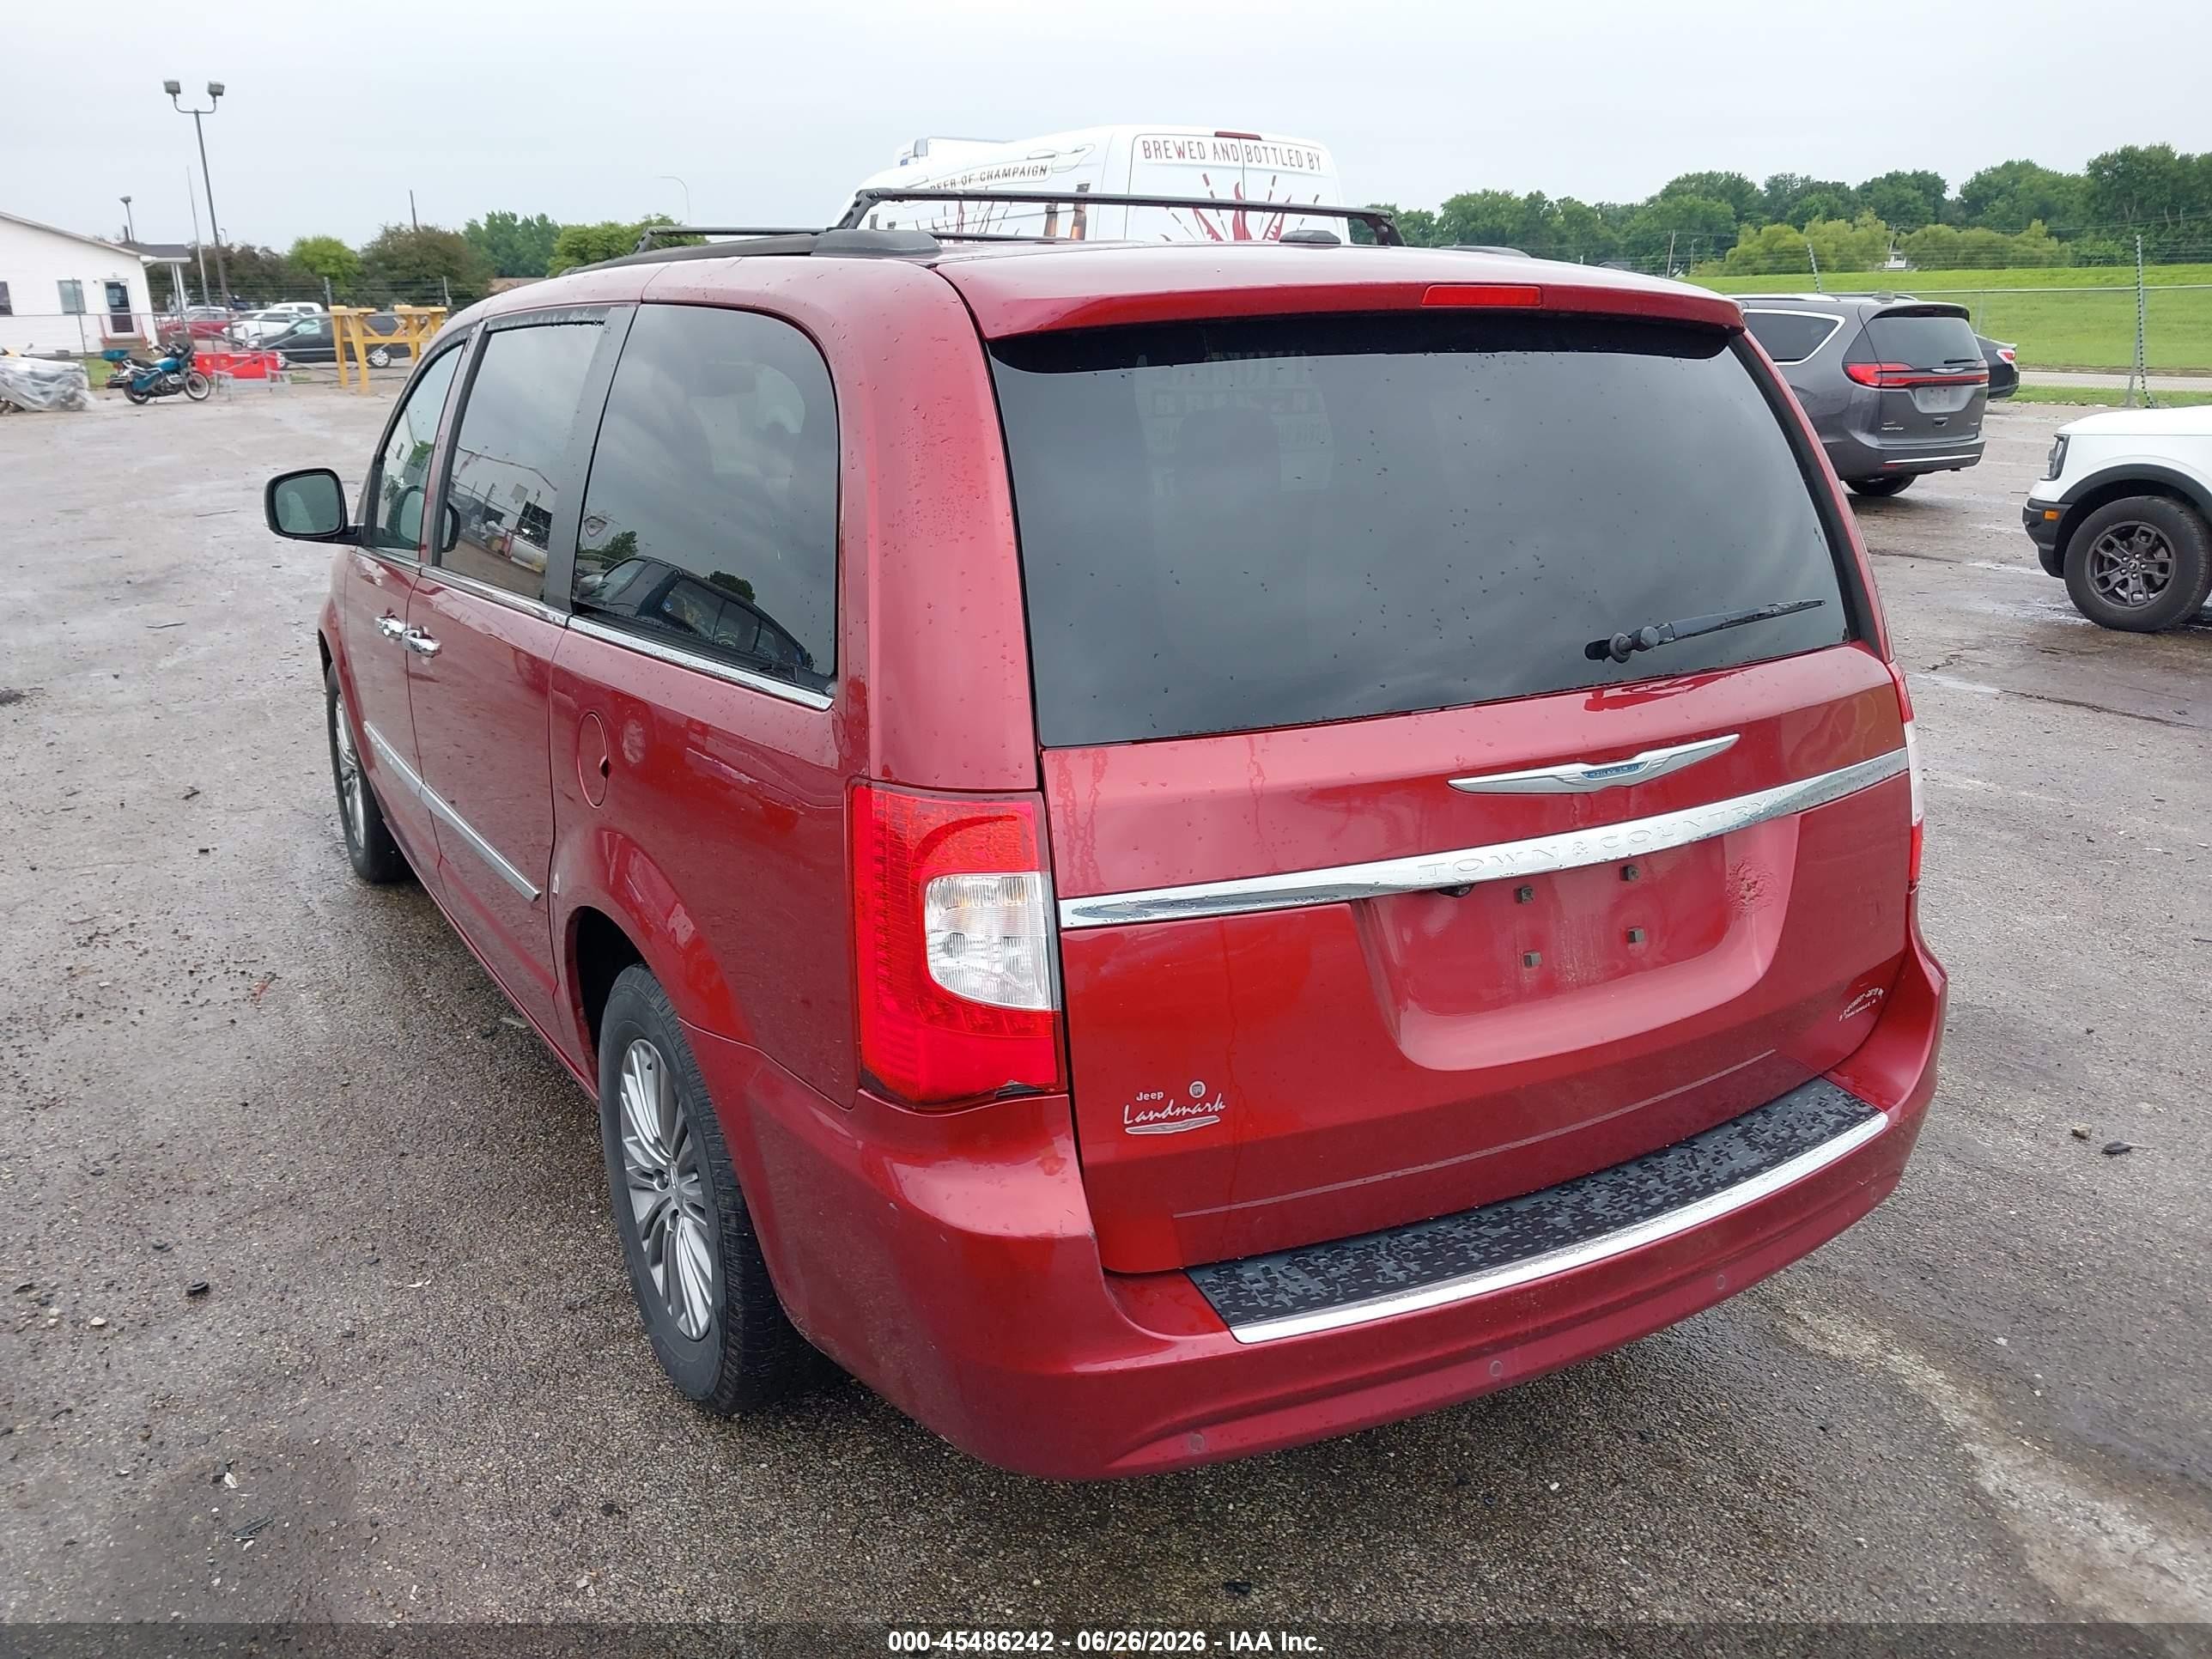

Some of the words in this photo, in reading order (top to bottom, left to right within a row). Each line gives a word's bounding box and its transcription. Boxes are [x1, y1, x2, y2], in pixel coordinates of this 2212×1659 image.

[1142, 140, 1206, 160] BREWED
[1212, 142, 1239, 161] AND
[1244, 144, 1303, 167] BOTTLED
[1307, 152, 1321, 172] BY
[961, 174, 975, 185] OF
[980, 164, 1048, 183] CHAMPAIGN
[1417, 846, 1559, 878] TOWN
[1599, 798, 1767, 849] COUNTRY
[1123, 1092, 1226, 1125] Landmark
[1135, 1091, 1164, 1102] Jeep
